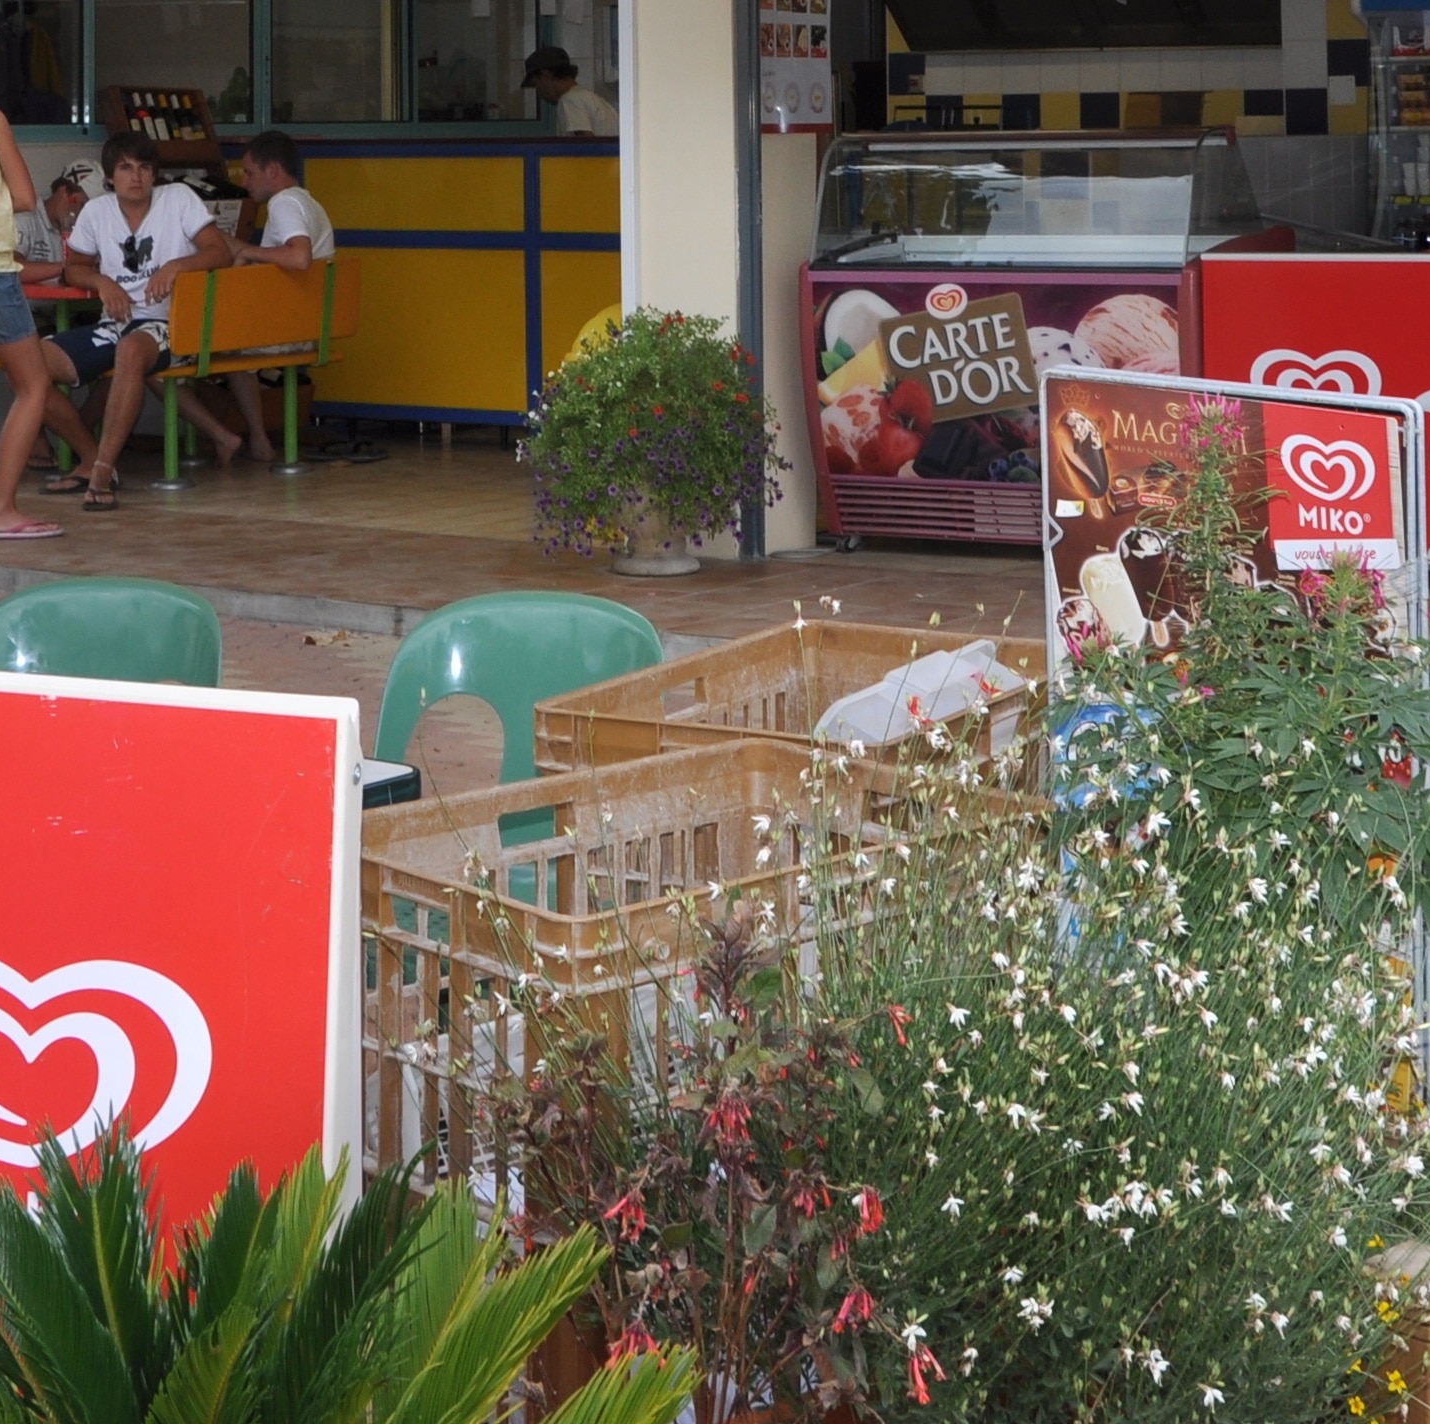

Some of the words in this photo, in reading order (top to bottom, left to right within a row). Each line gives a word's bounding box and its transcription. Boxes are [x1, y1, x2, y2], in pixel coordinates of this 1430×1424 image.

[888, 311, 1017, 369] CARTE
[927, 355, 1035, 406] D'OR
[1298, 502, 1365, 537] MIKO
[1294, 549, 1322, 561] vous
